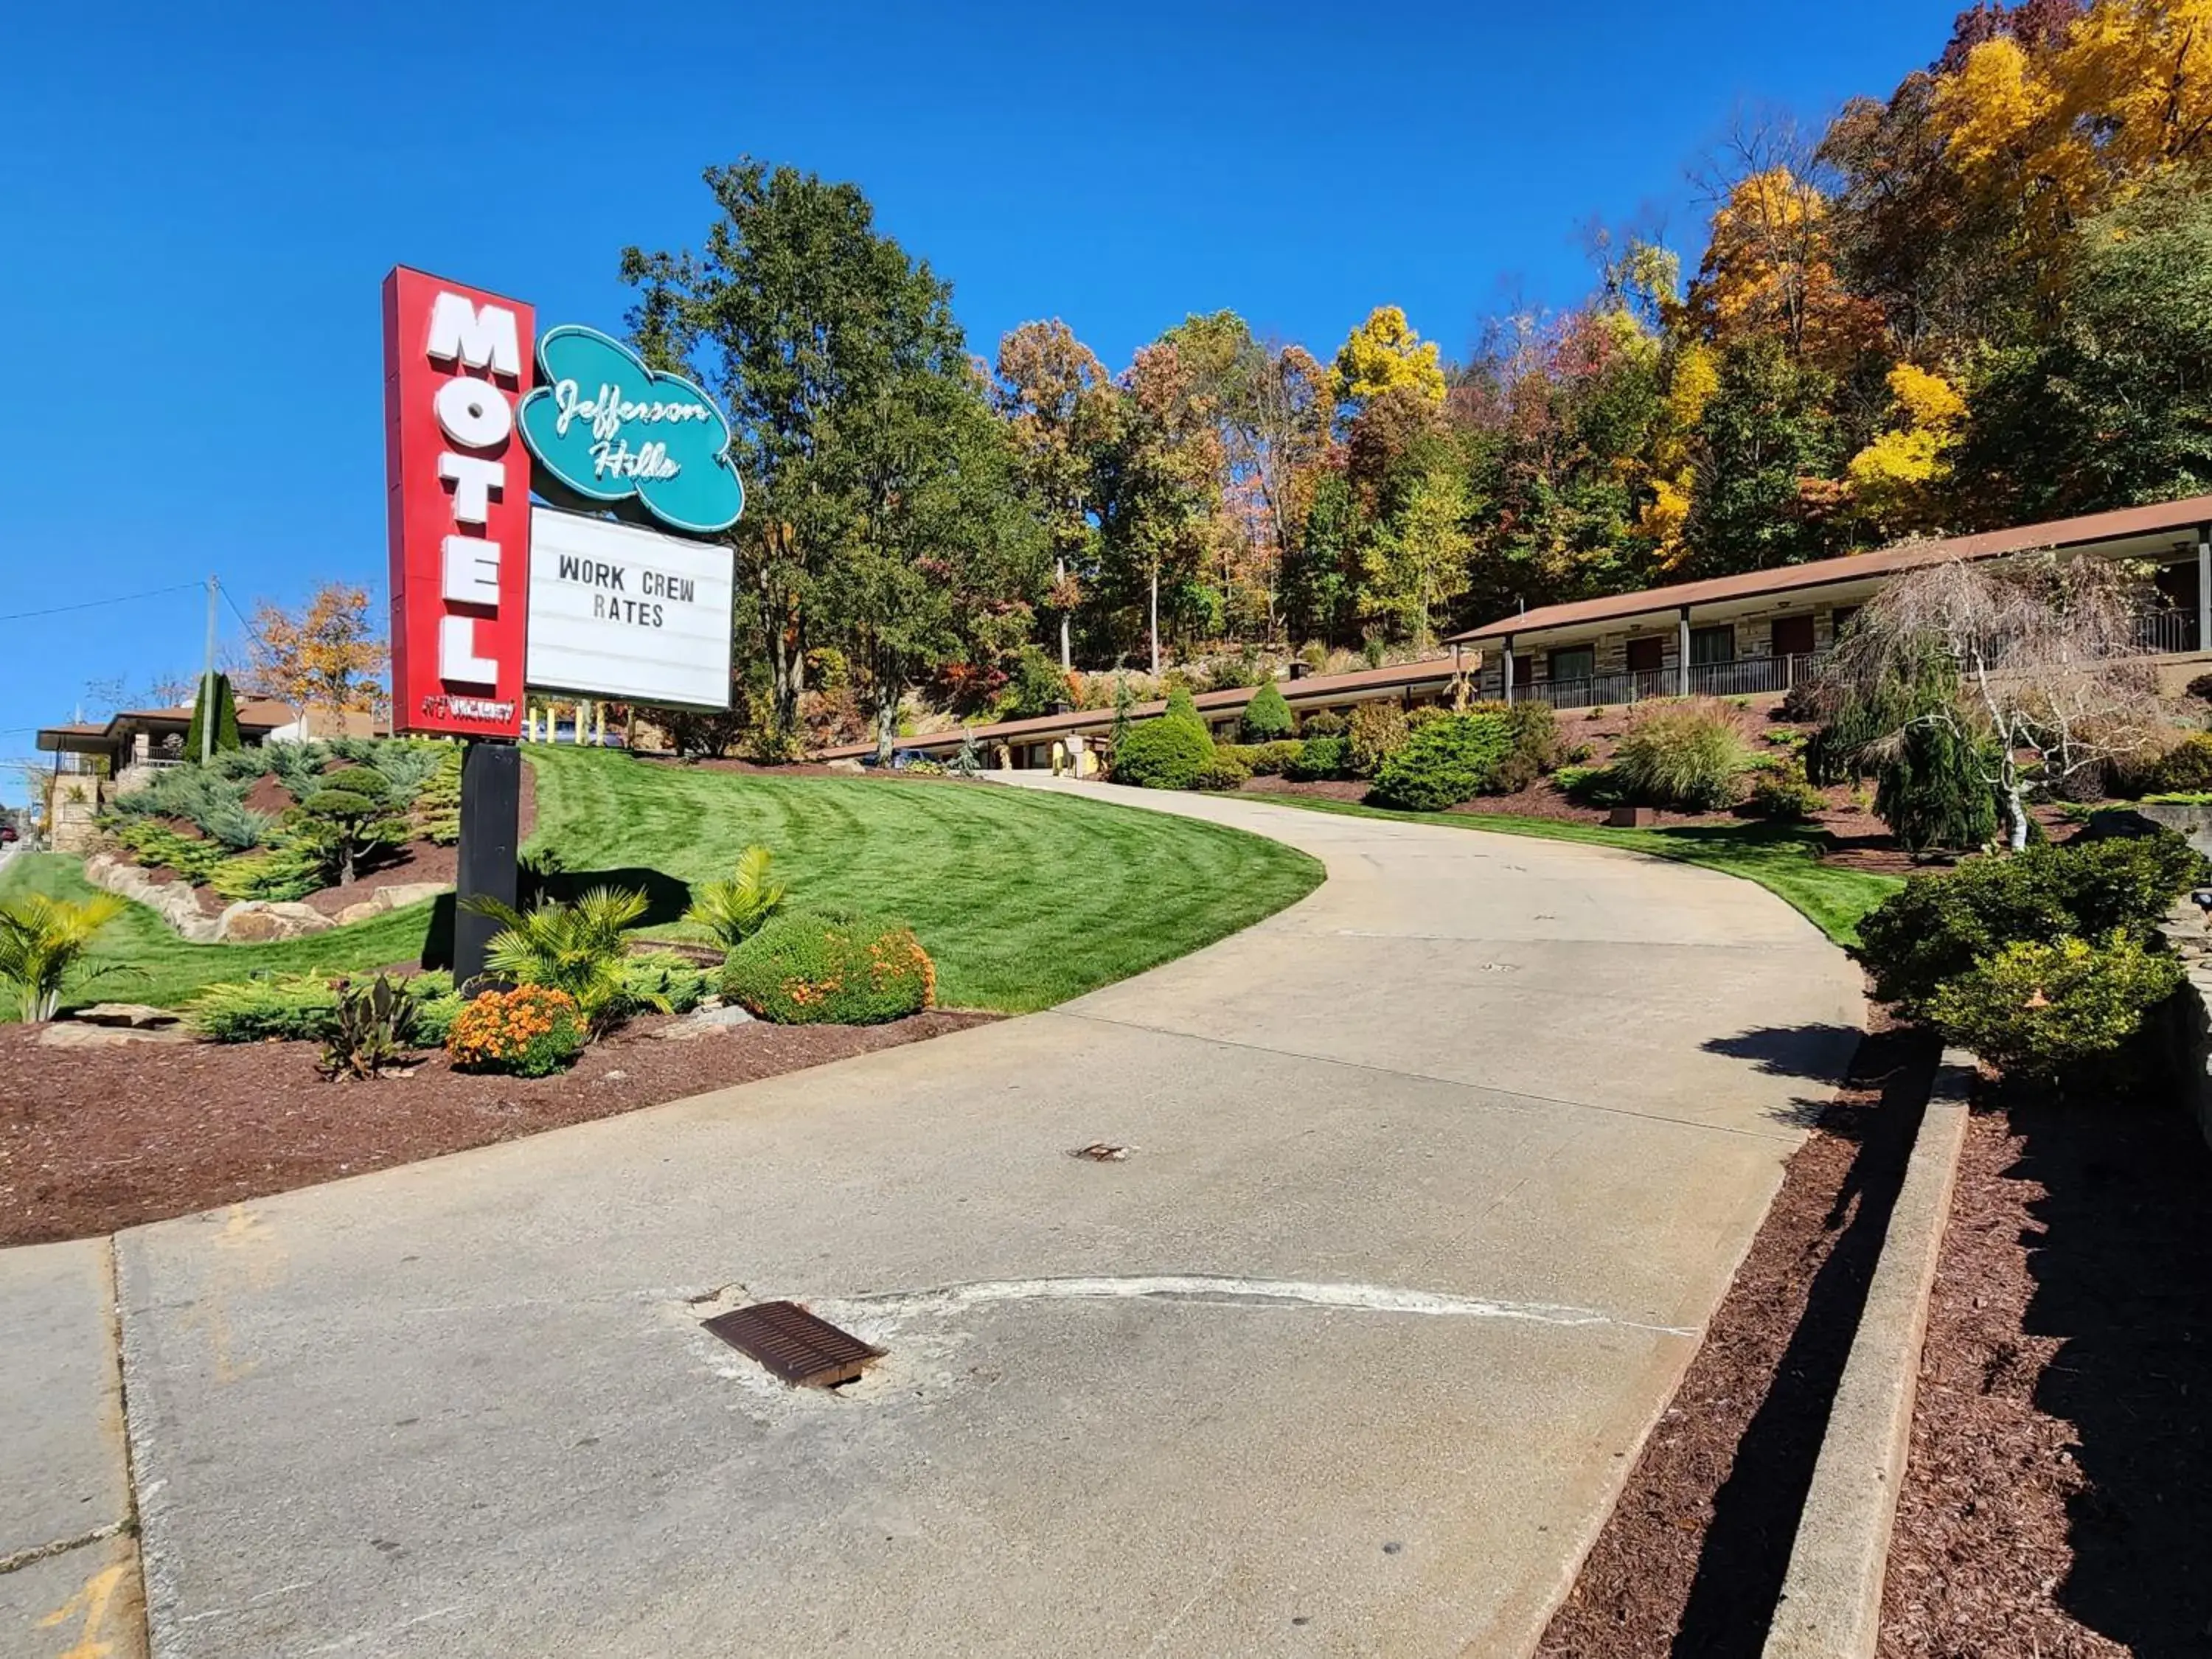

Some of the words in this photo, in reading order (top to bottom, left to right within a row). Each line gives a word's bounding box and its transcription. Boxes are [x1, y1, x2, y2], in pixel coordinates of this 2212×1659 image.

[556, 379, 709, 439] Jefferson
[588, 441, 679, 480] Hills
[426, 291, 521, 684] MOTEL
[559, 554, 625, 591] WORK
[643, 571, 695, 602] CREW
[594, 594, 664, 627] RATES
